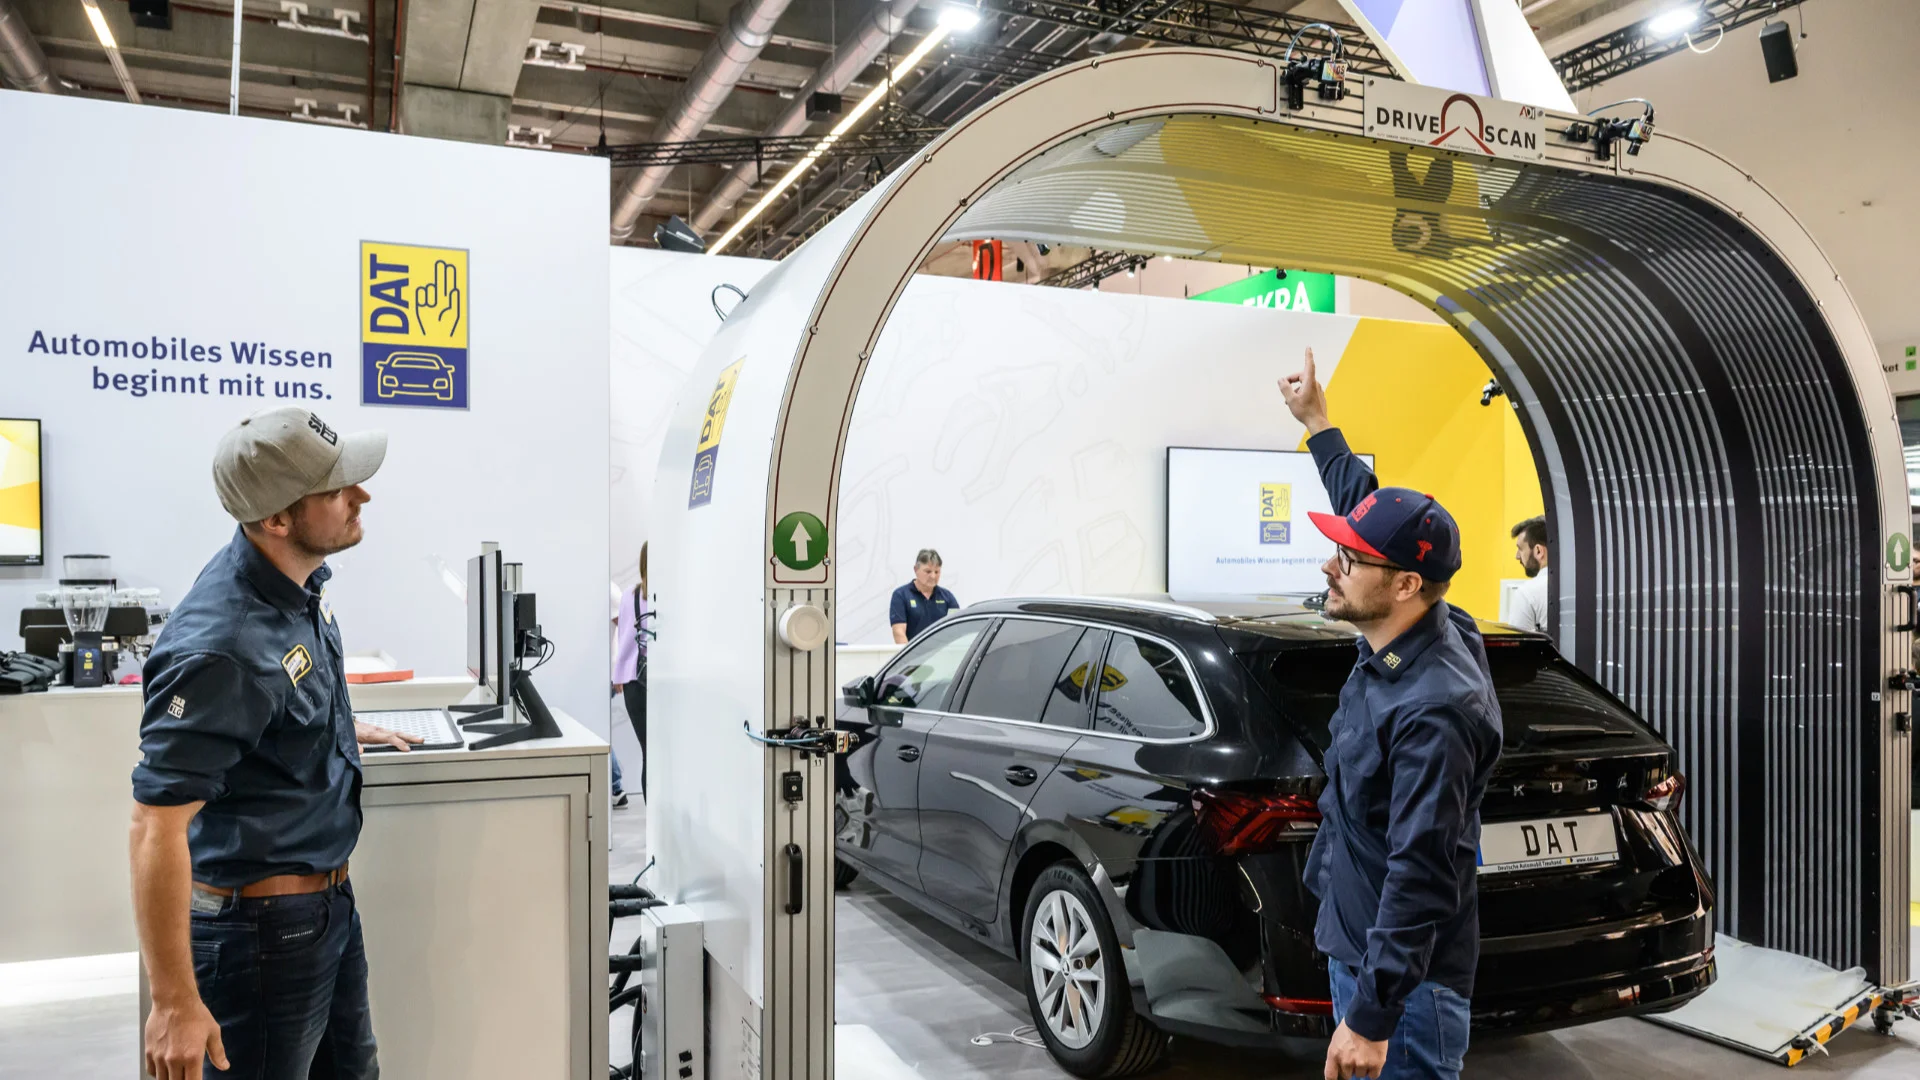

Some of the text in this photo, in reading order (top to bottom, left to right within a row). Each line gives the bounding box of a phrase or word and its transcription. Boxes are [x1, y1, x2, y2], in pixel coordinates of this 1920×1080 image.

[1376, 107, 1536, 150] DRIVE SCAN
[369, 253, 409, 334] DAT
[28, 330, 332, 368] Automobiles Wissen
[93, 365, 332, 400] beginnt mit uns.
[700, 378, 726, 445] DAT
[1262, 487, 1274, 517] DAT
[1216, 557, 1256, 565] Automobiles
[1520, 820, 1578, 857] DAT
